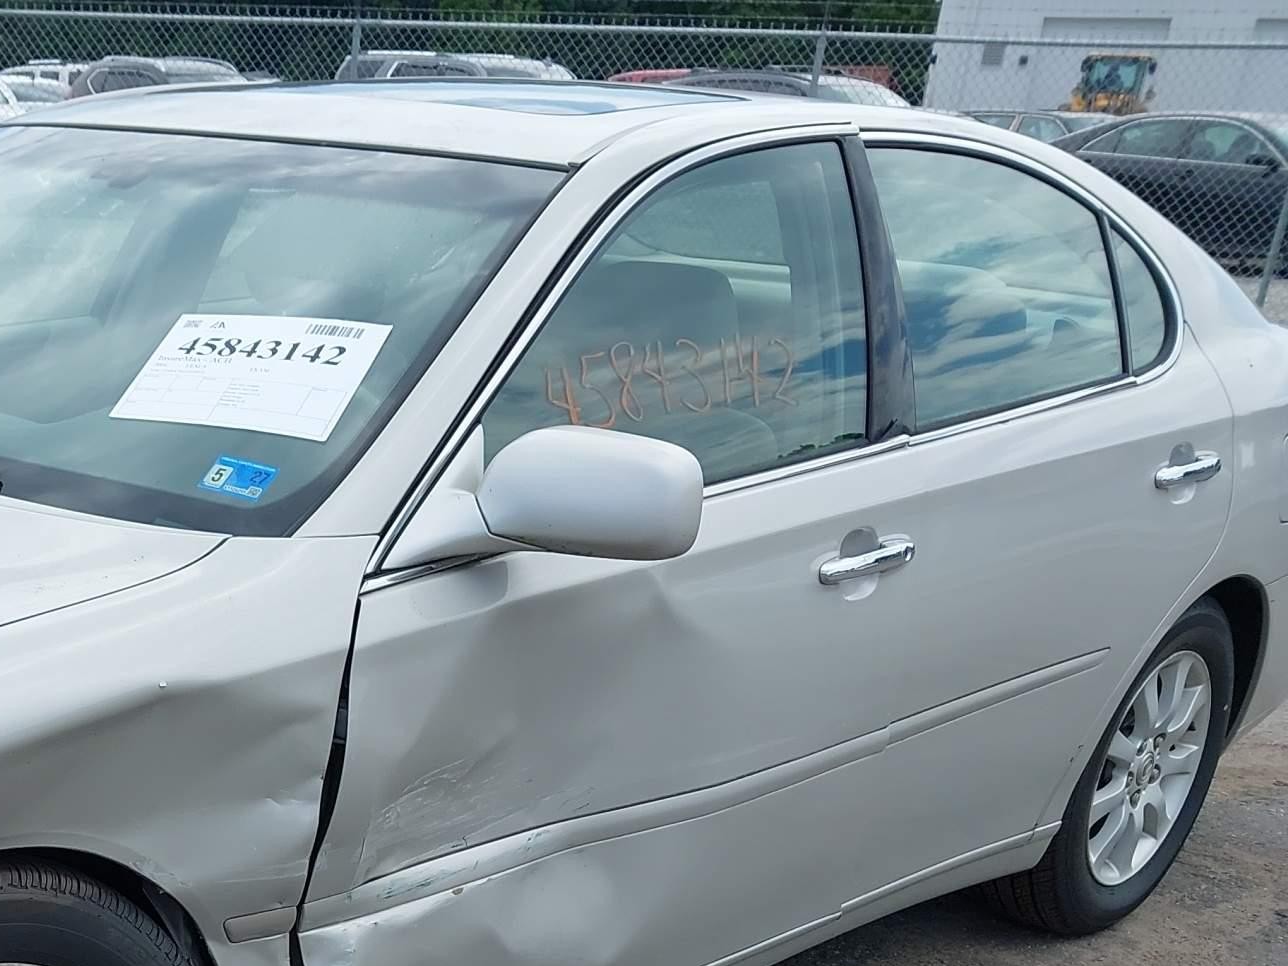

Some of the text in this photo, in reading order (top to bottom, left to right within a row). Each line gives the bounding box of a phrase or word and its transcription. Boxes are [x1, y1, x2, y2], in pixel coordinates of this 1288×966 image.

[178, 336, 348, 366] 45843142
[544, 331, 798, 428] 45843142
[210, 468, 227, 483] 5
[249, 471, 272, 485] 27
